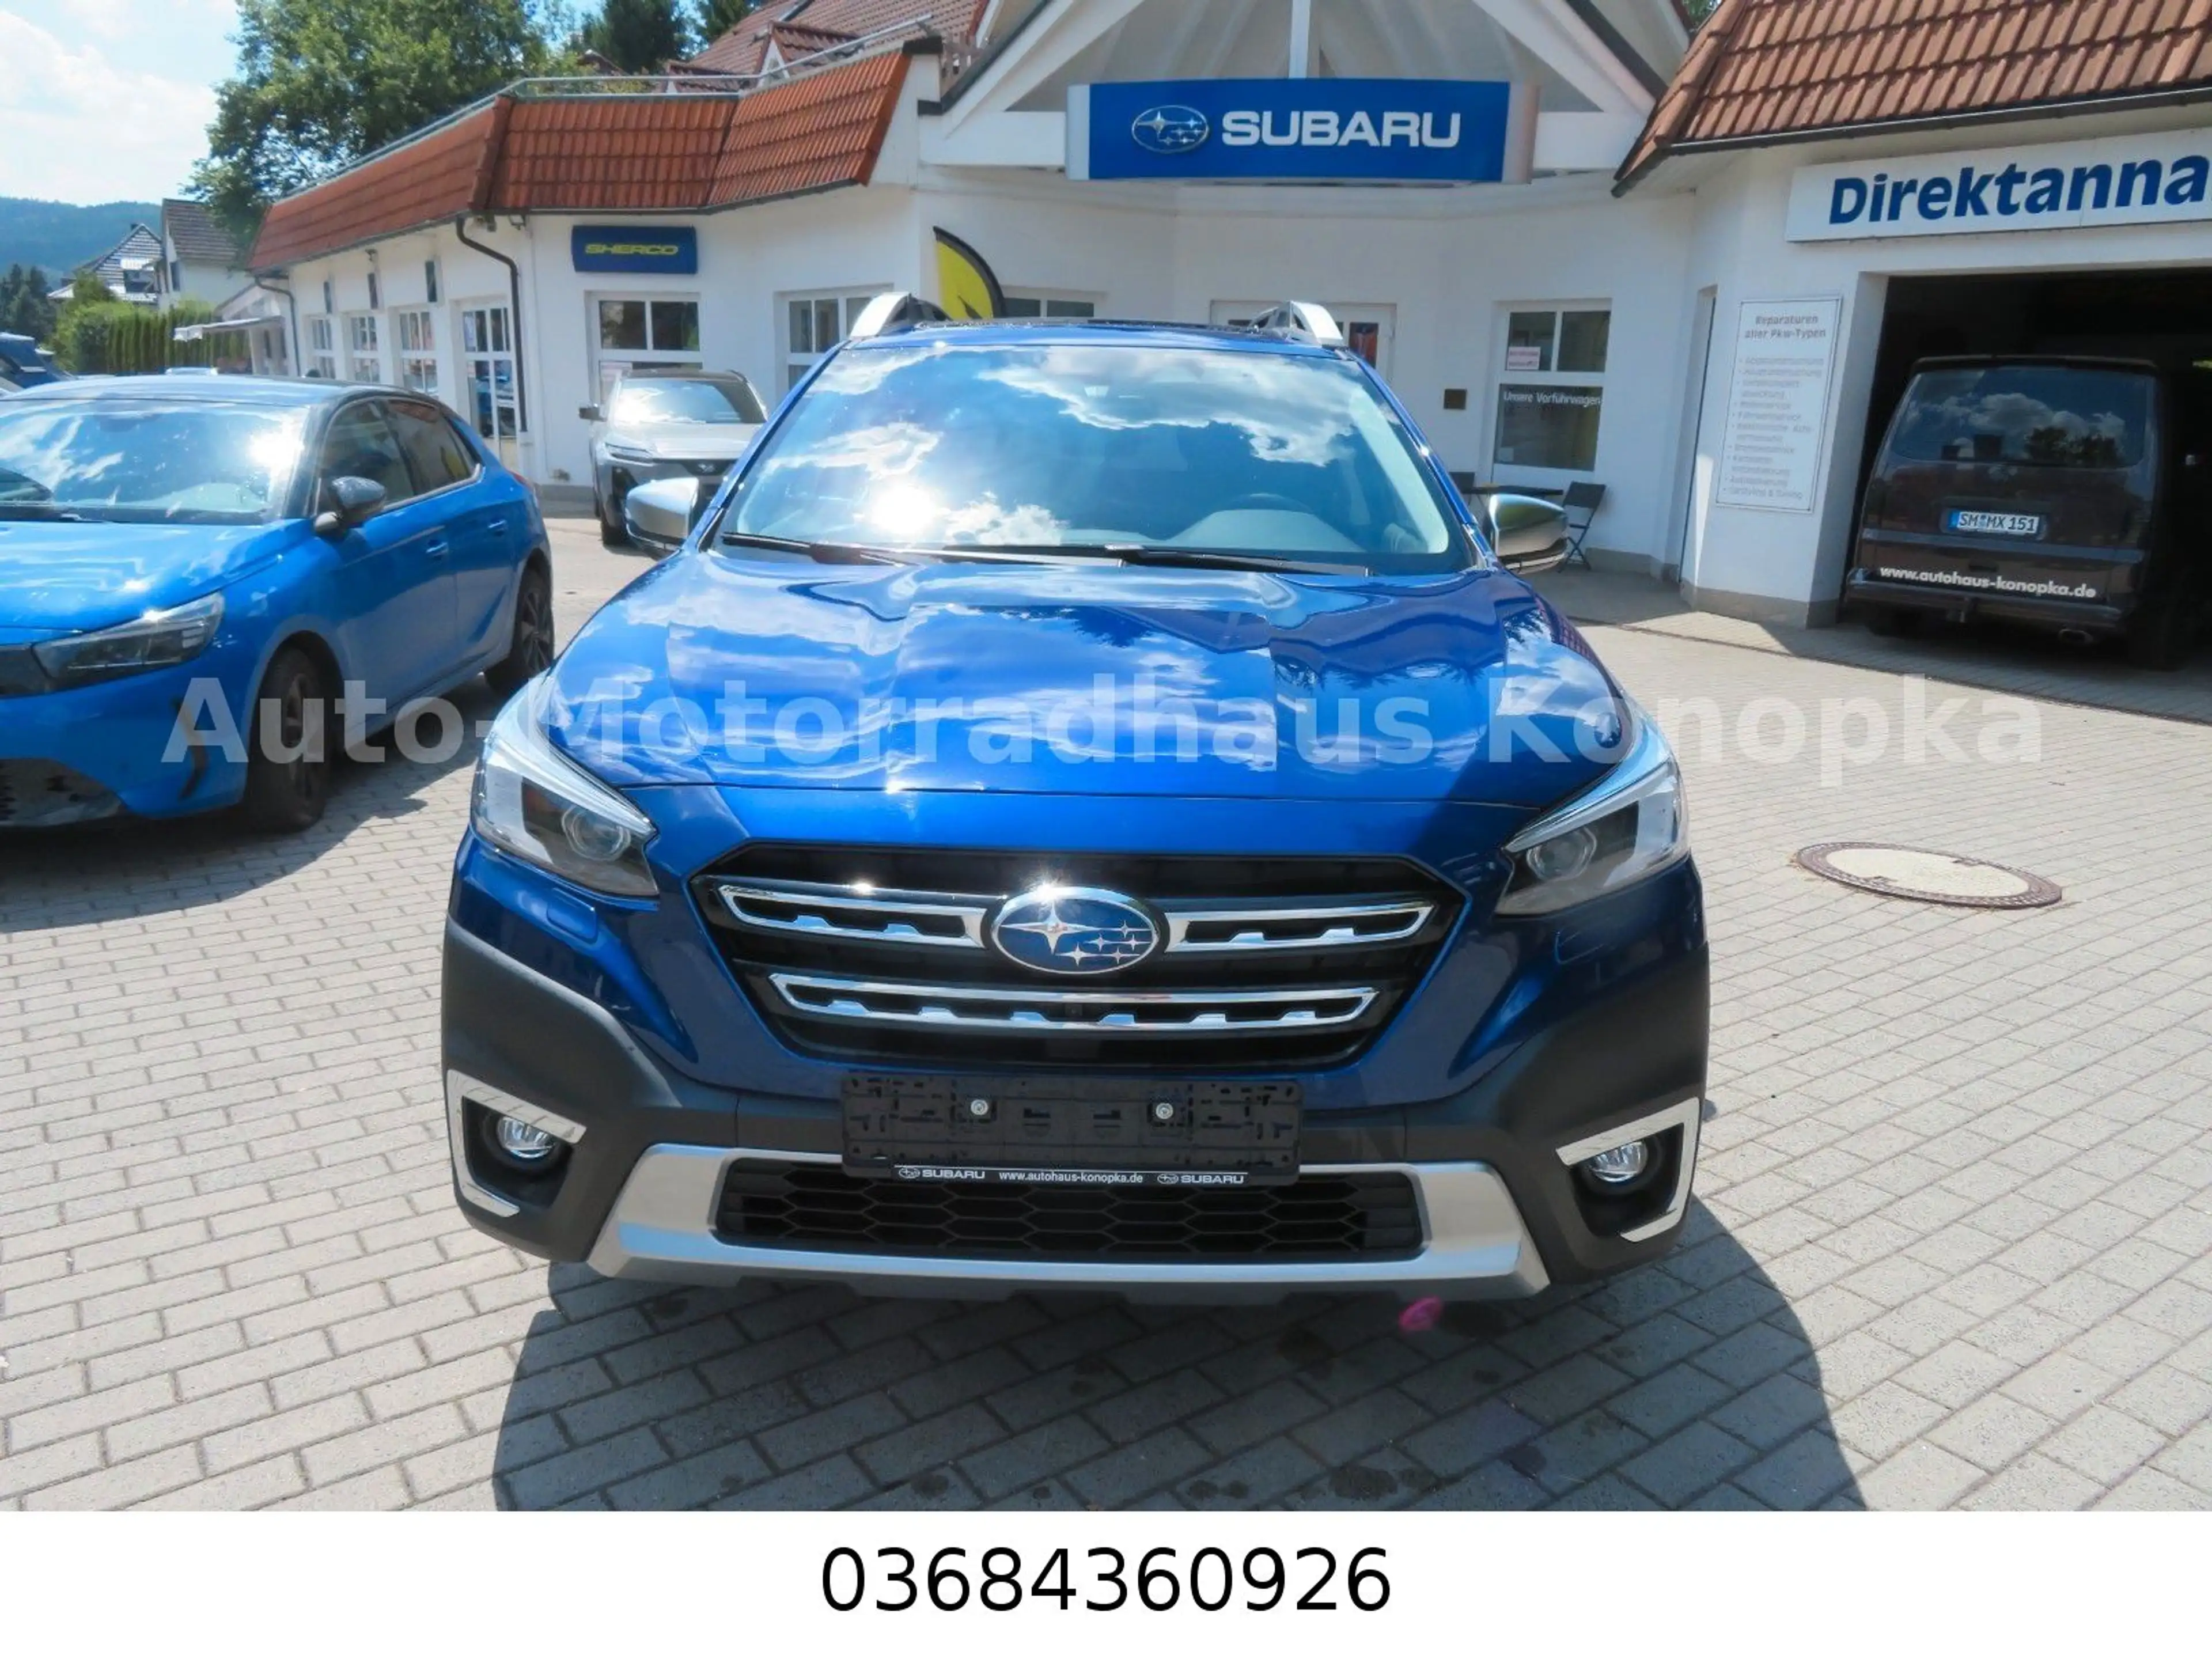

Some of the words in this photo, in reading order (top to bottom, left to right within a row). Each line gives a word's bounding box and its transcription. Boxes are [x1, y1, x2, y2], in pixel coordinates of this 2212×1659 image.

[1222, 110, 1461, 148] SUBARU
[1828, 155, 2211, 225] Direktanna
[585, 244, 679, 255] SHERCO
[1755, 315, 1819, 326] Reparaturen
[1744, 329, 1768, 338] aller
[1503, 391, 1533, 403] Unsere
[1960, 514, 1978, 527] SM
[1987, 516, 2005, 529] MX
[2008, 517, 2035, 531] 151
[1880, 566, 2097, 598] www.autohaus-konopka.de
[922, 1169, 986, 1179] SUBARU
[998, 1170, 1143, 1184] www.autohaus-konopka.de
[1180, 1174, 1244, 1184] SUBARU
